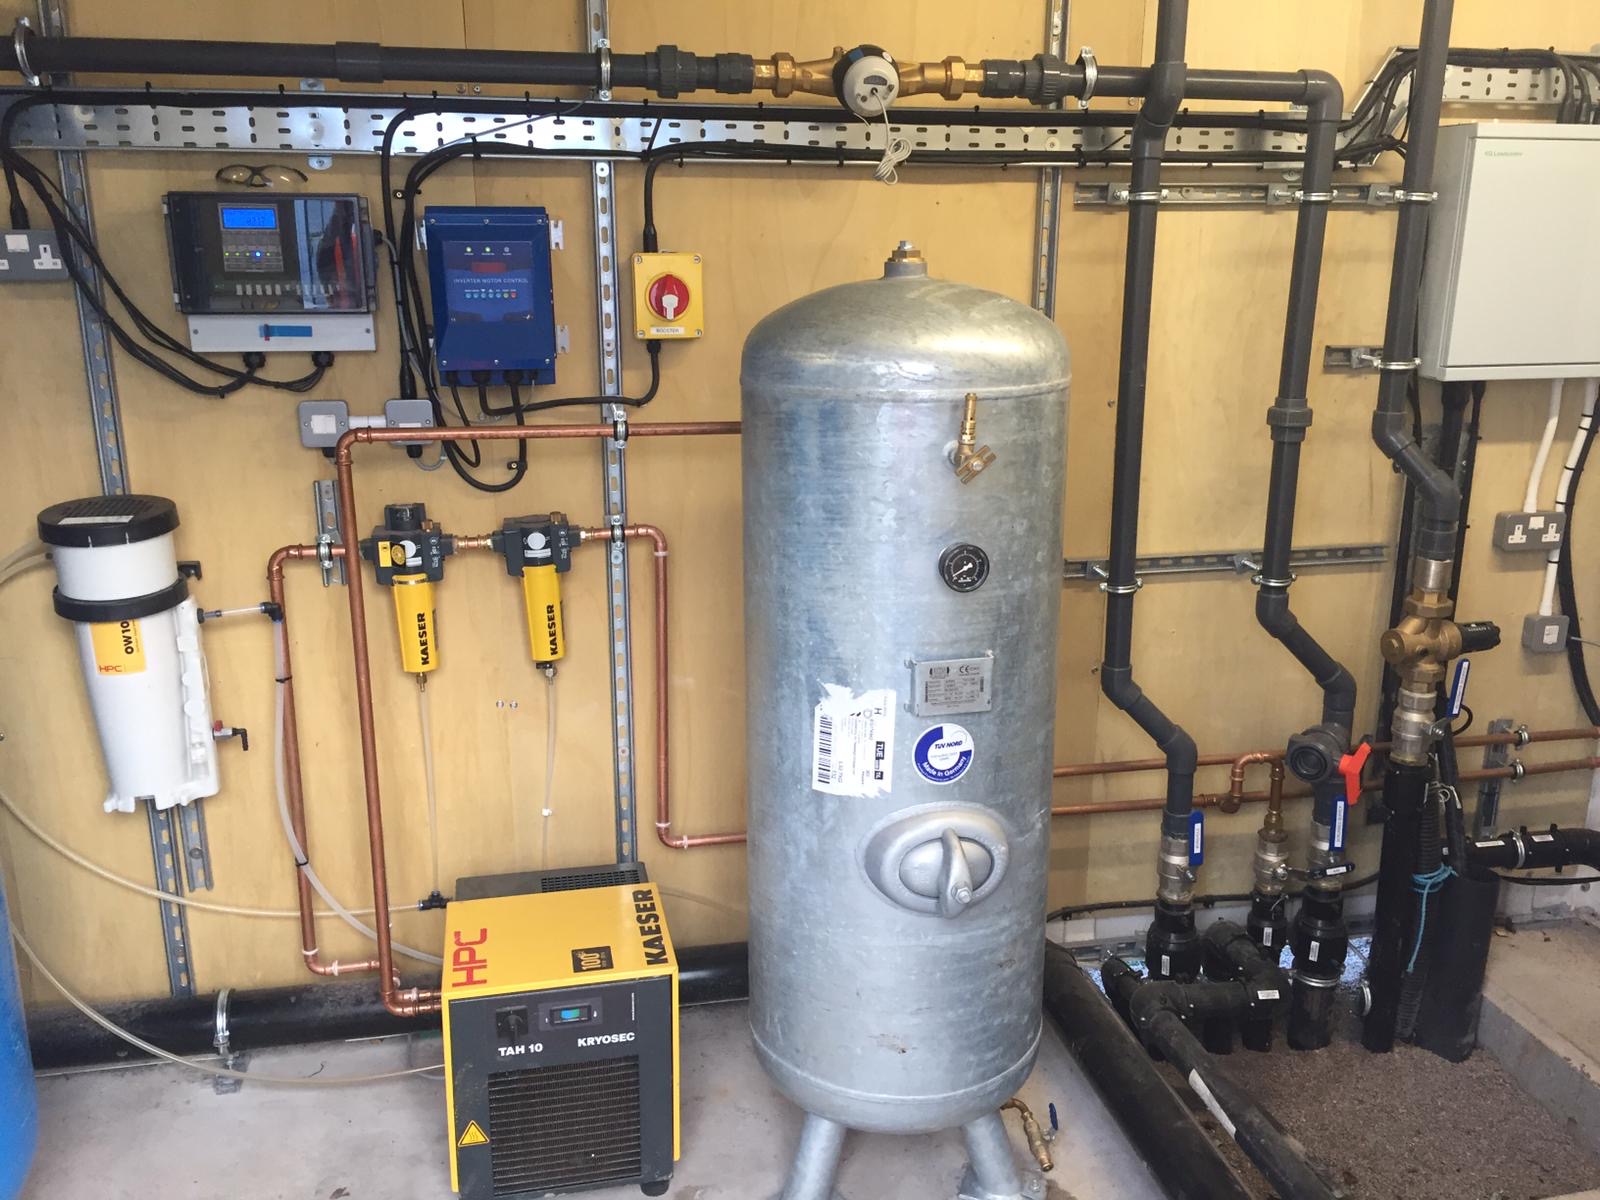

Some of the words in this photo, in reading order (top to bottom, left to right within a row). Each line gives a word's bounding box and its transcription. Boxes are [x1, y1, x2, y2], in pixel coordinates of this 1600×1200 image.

[417, 612, 430, 666] KAESER
[546, 604, 558, 656] KAESER
[99, 665, 123, 673] HPC
[946, 740, 963, 748] NORD
[922, 761, 937, 776] Made
[944, 756, 967, 776] Germany
[632, 889, 669, 966] KAESER
[452, 928, 488, 988] HPC
[498, 1044, 525, 1057] TAH
[528, 1042, 543, 1053] 10
[577, 1032, 636, 1047] KRYOSEC
